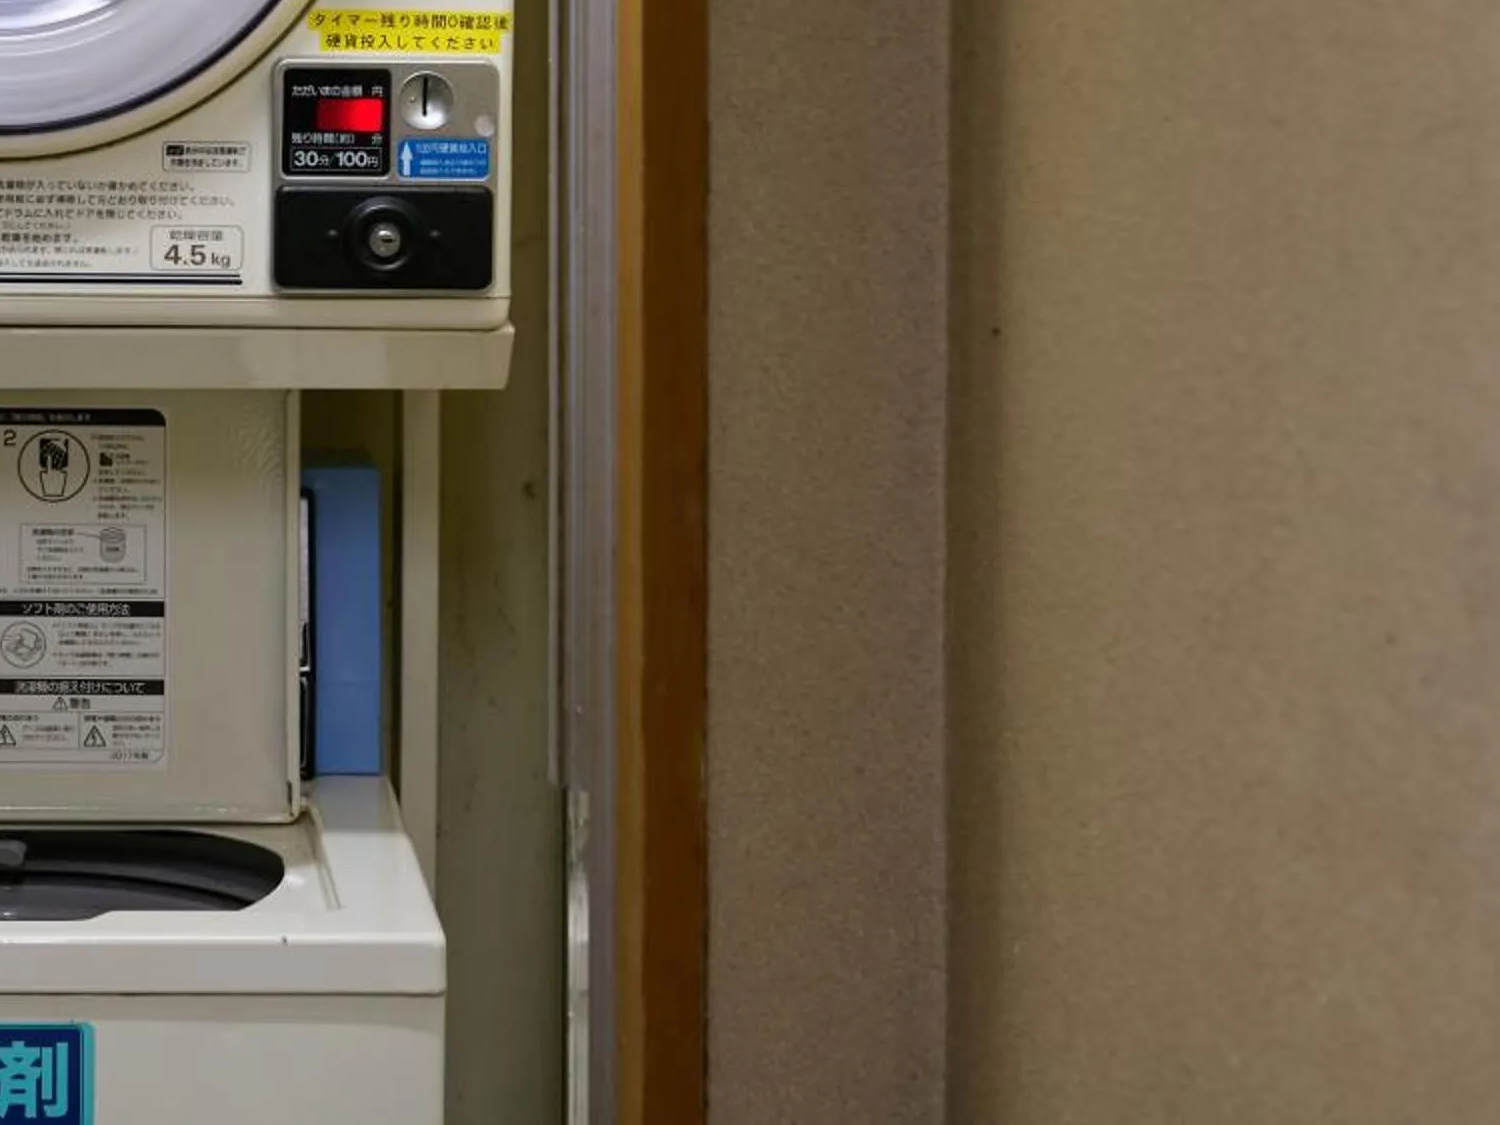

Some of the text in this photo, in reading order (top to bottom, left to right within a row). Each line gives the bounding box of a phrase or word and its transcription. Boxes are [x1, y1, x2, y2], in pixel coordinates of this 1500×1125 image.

[325, 34, 493, 49] 硬貨投入してください
[164, 244, 231, 268] 4.5 kg
[3, 430, 17, 446] 2
